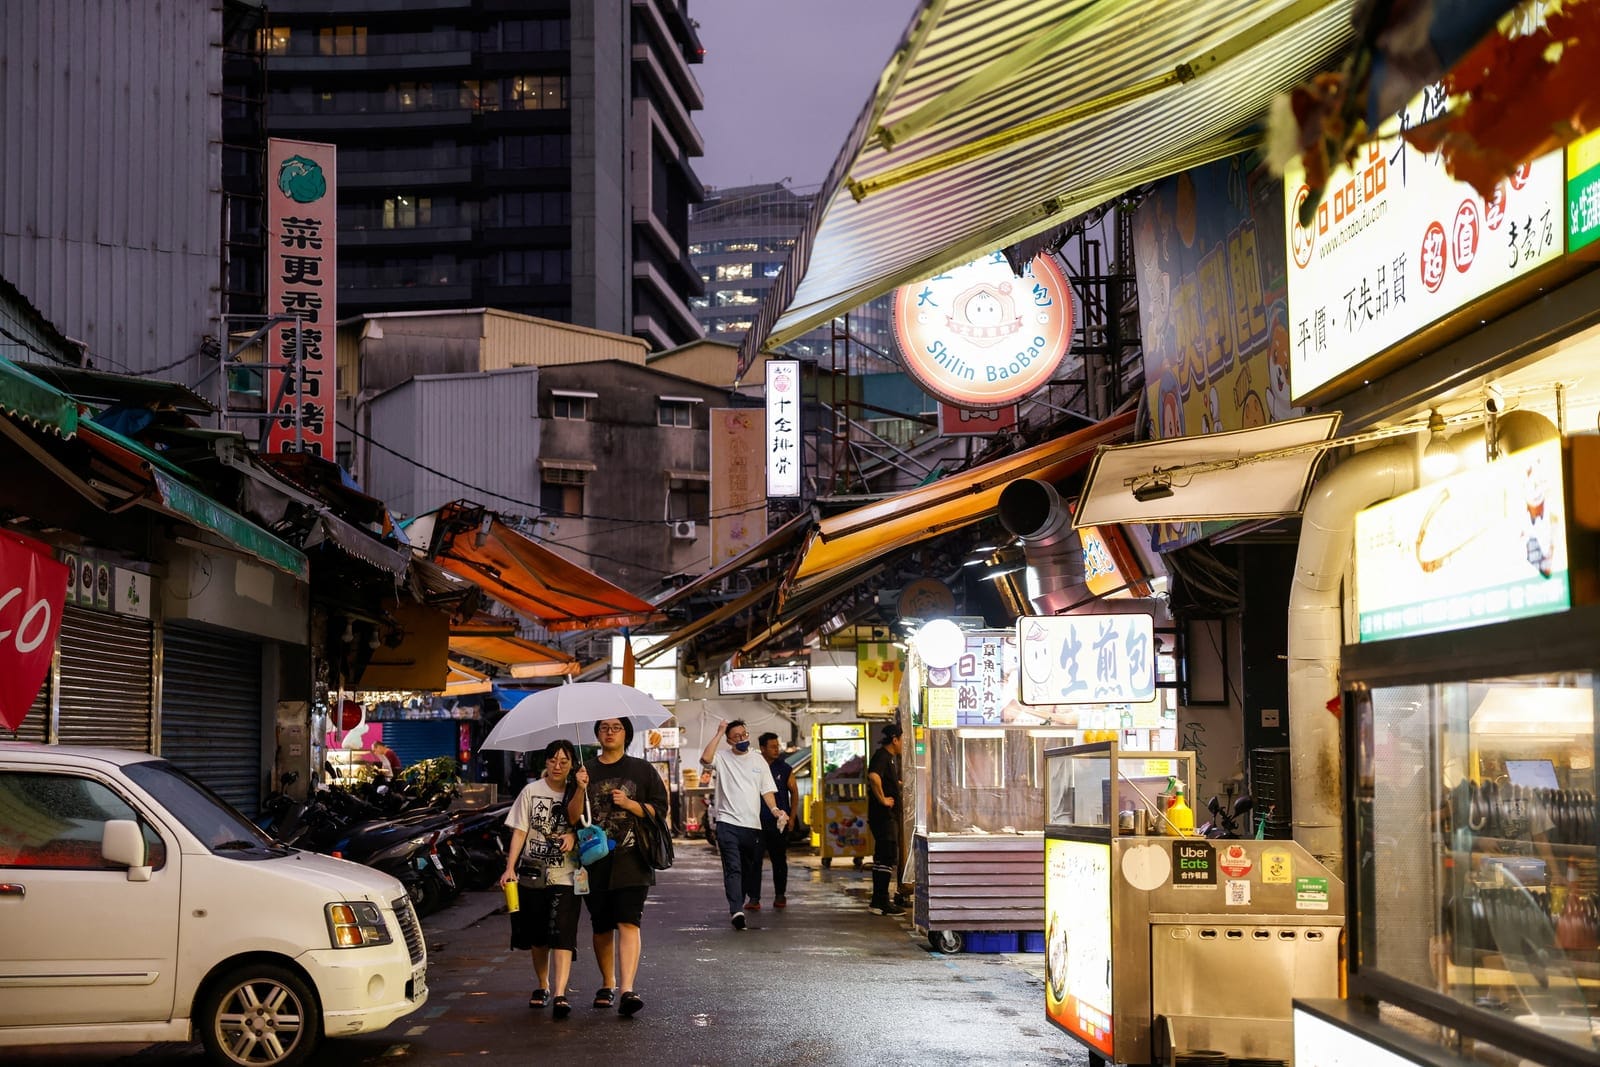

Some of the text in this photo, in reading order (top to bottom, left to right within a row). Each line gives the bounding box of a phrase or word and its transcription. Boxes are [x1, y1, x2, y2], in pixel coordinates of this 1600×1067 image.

[926, 335, 1046, 382] Shilin BaoBao
[773, 396, 794, 474] 十全排骨
[958, 653, 978, 710] 日船
[983, 644, 996, 719] 章魚小丸子
[1060, 618, 1153, 699] 生煎包
[1180, 847, 1208, 858] Uber
[1180, 858, 1209, 869] Eats
[1181, 871, 1209, 880] 合作餐廳
